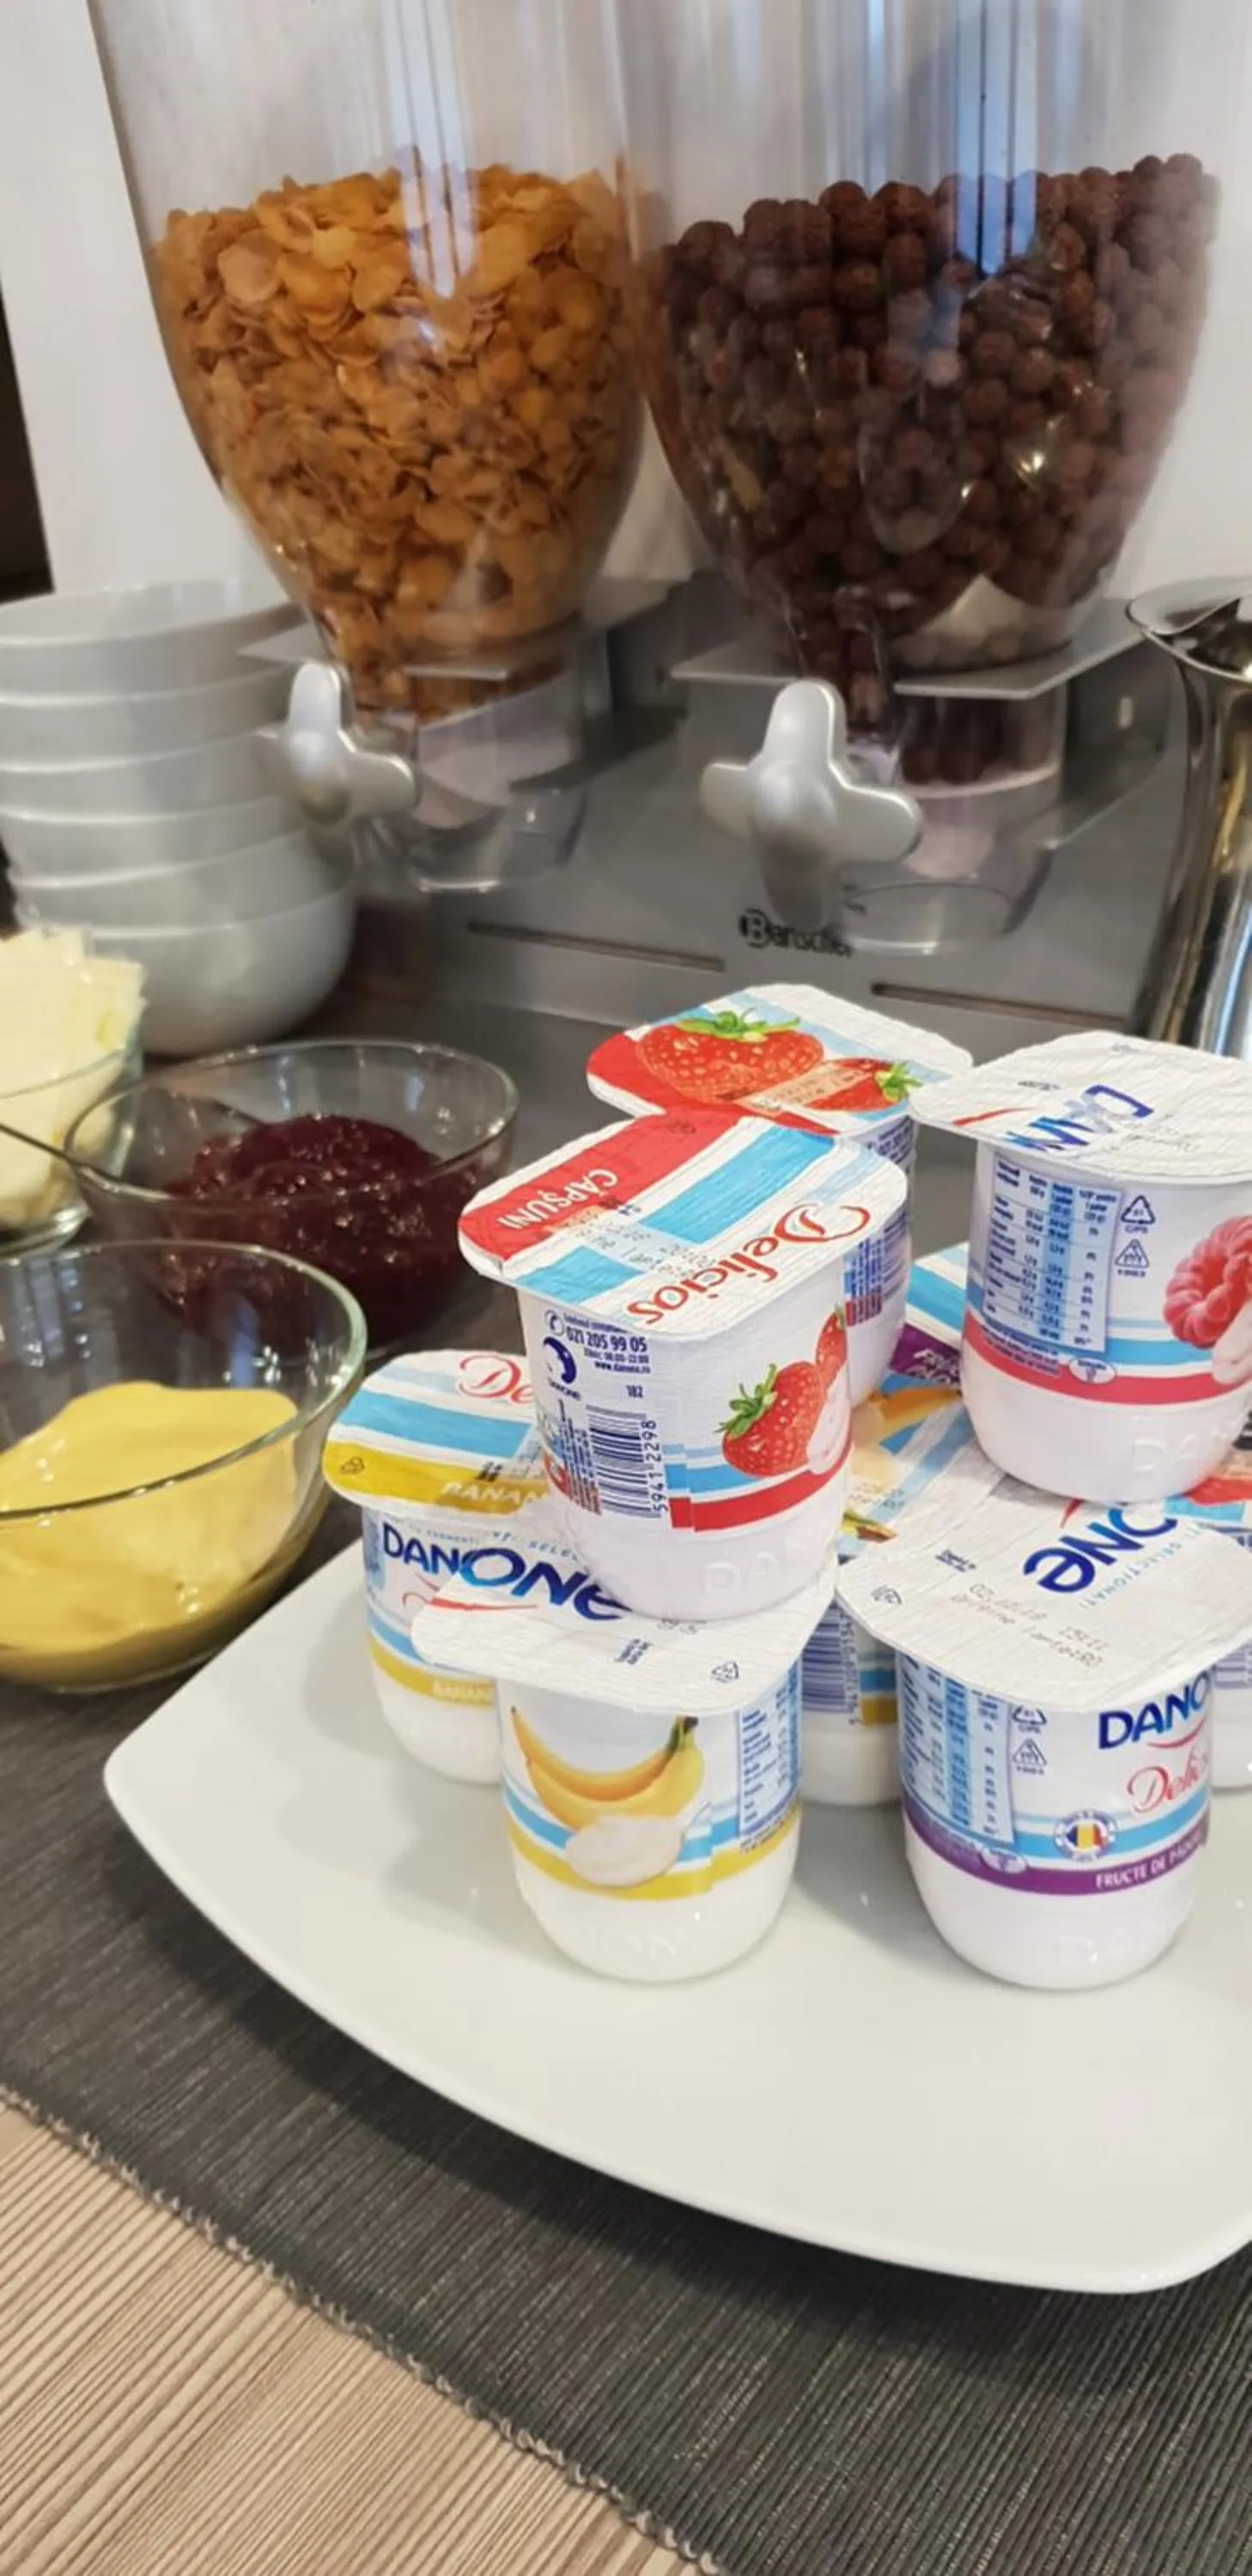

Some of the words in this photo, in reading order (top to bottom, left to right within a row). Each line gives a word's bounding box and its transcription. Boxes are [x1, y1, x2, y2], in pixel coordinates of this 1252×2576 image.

[627, 1200, 872, 1326] Delicios
[586, 1331, 608, 1350] 205
[610, 1335, 627, 1352] 99
[629, 1335, 647, 1353] 05
[1096, 1862, 1149, 1889] FRUCTE
[1151, 1854, 1166, 1874] DE
